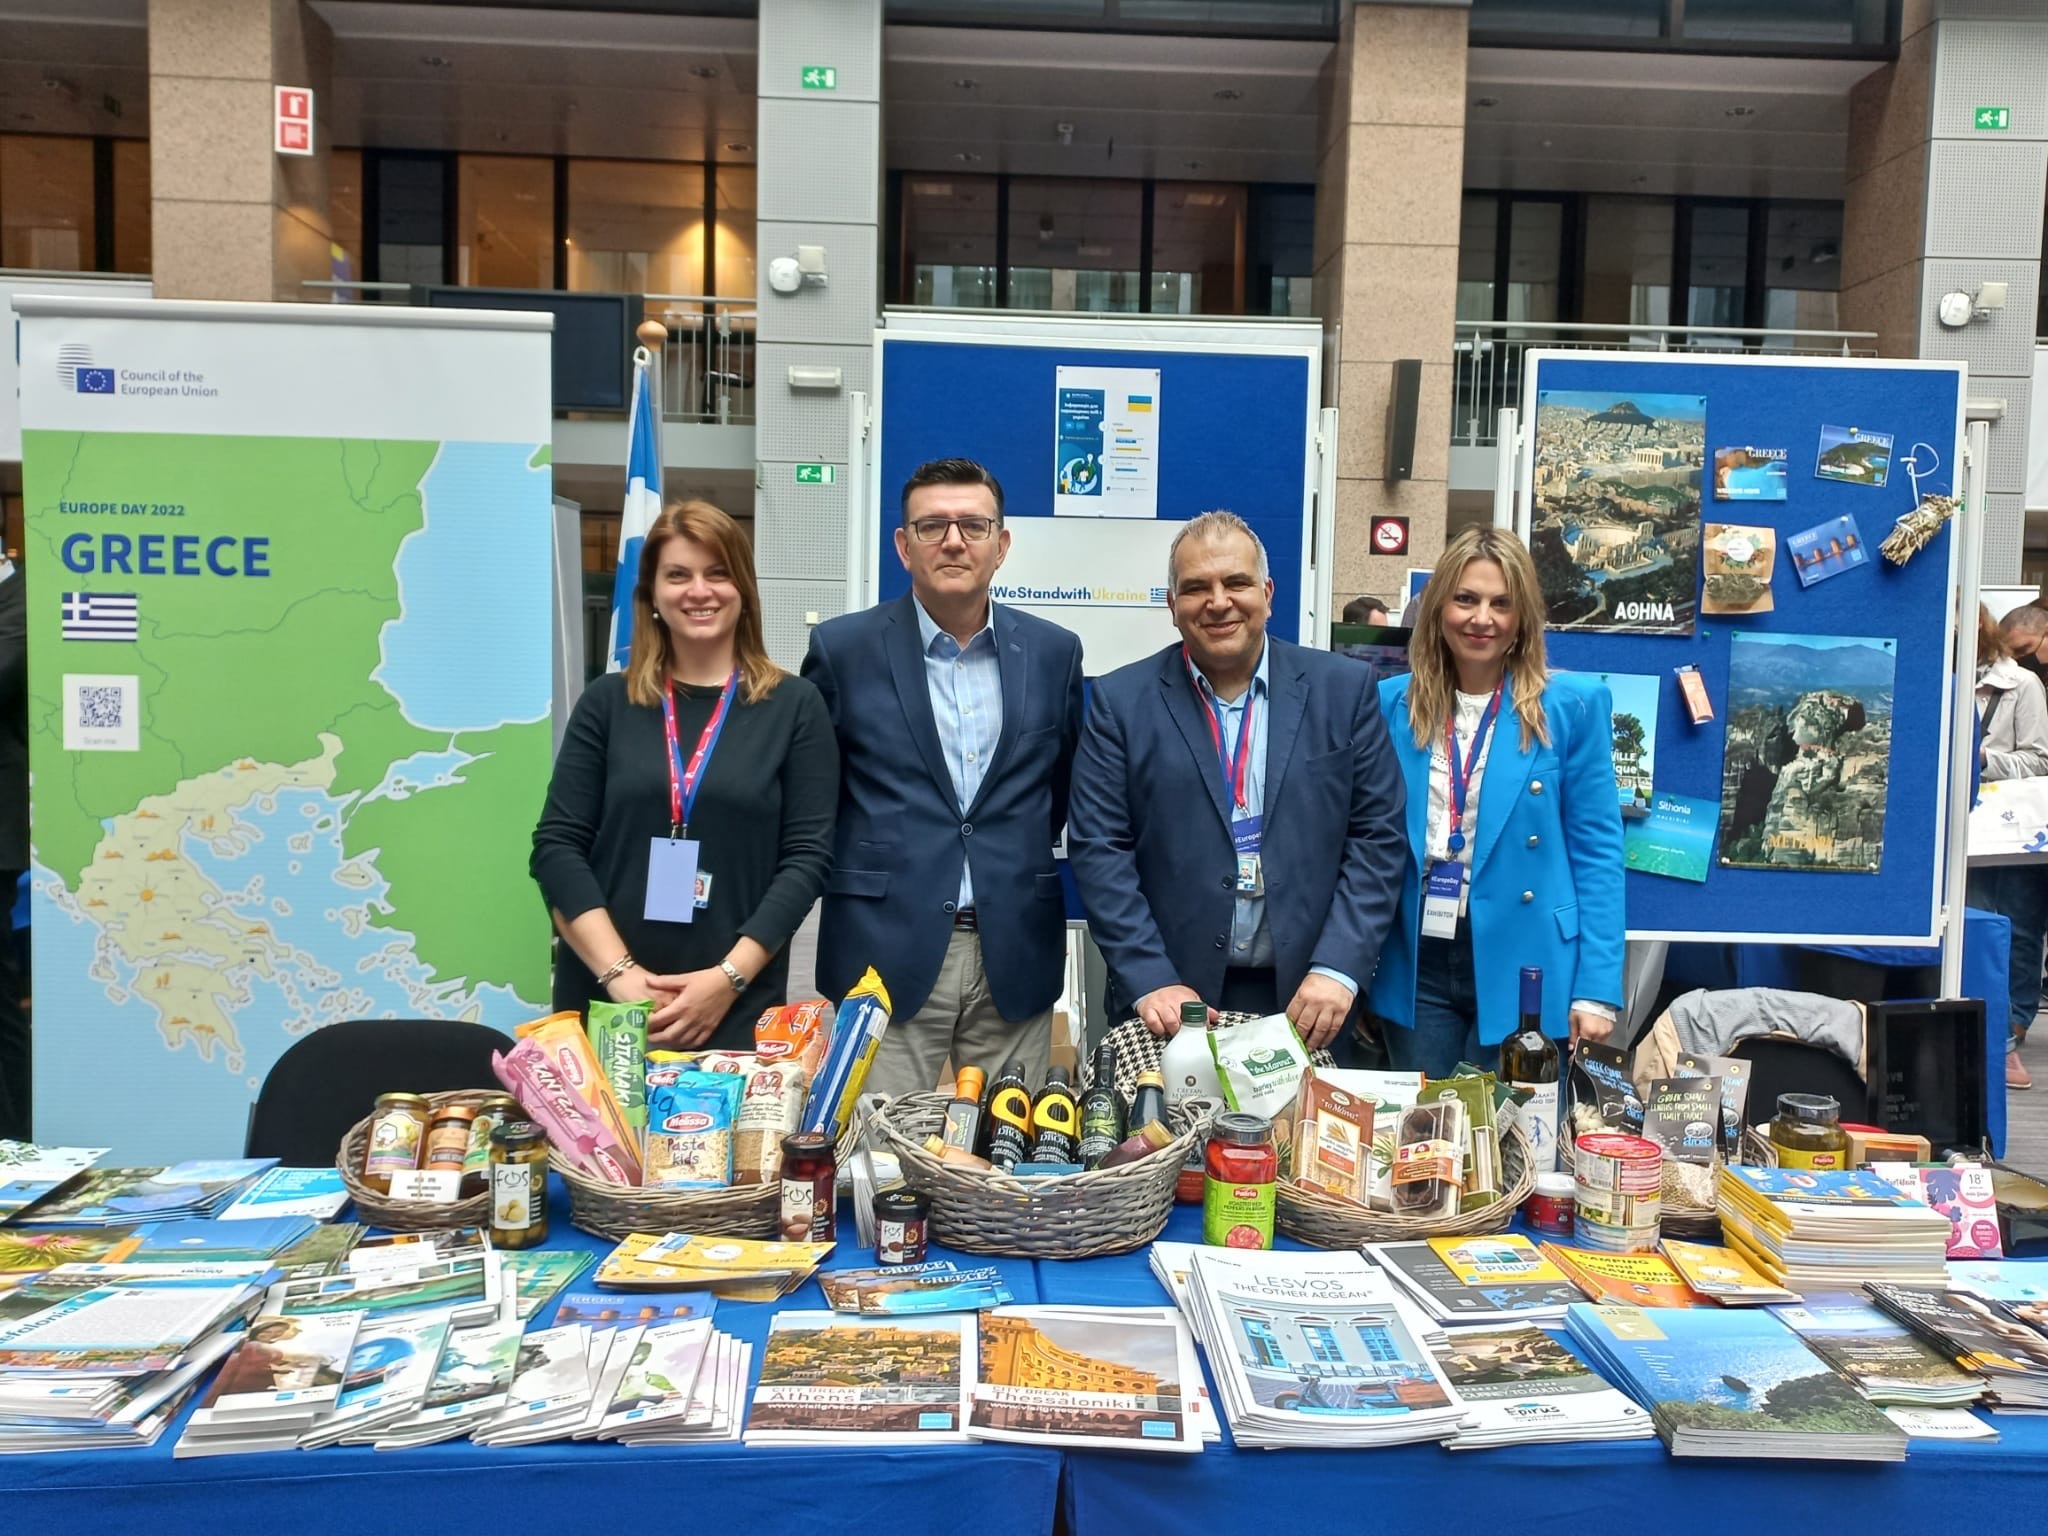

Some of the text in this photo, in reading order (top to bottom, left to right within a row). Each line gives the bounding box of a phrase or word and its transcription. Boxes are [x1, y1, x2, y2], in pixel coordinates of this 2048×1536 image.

[121, 369, 204, 383] Council of the
[121, 384, 219, 398] European Union
[1854, 433, 1891, 449] GREECE
[1749, 448, 1788, 460] GREECE
[59, 502, 185, 517] EUROPE DAY 2022
[61, 532, 271, 577] GREECE
[988, 586, 1148, 602] #WeStandwithUkraine
[1658, 800, 1692, 815] Sithonia
[1426, 909, 1455, 919] EXHIBITOR
[668, 1113, 709, 1129] Melissa
[667, 1138, 707, 1152] Pasta
[672, 1152, 700, 1166] kids
[1578, 1253, 1650, 1266] CAMPING
[879, 1261, 947, 1276] GREECE
[1474, 1263, 1539, 1274] EPIRUS
[919, 1270, 991, 1285] GREECE
[1254, 1275, 1344, 1292] LESVOS
[1233, 1282, 1260, 1293] THE
[1262, 1286, 1309, 1299] OTHER
[769, 1392, 856, 1402] Athens
[992, 1385, 1070, 1397] CITY BREAK
[1511, 1389, 1532, 1397] TO
[1532, 1385, 1580, 1395] CULTURE
[767, 1402, 874, 1413] www.visitgreece.gr
[994, 1391, 1132, 1410] Thessaloniki
[990, 1402, 1095, 1416] www.visitgreece.gr
[1504, 1406, 1562, 1417] Epirus
